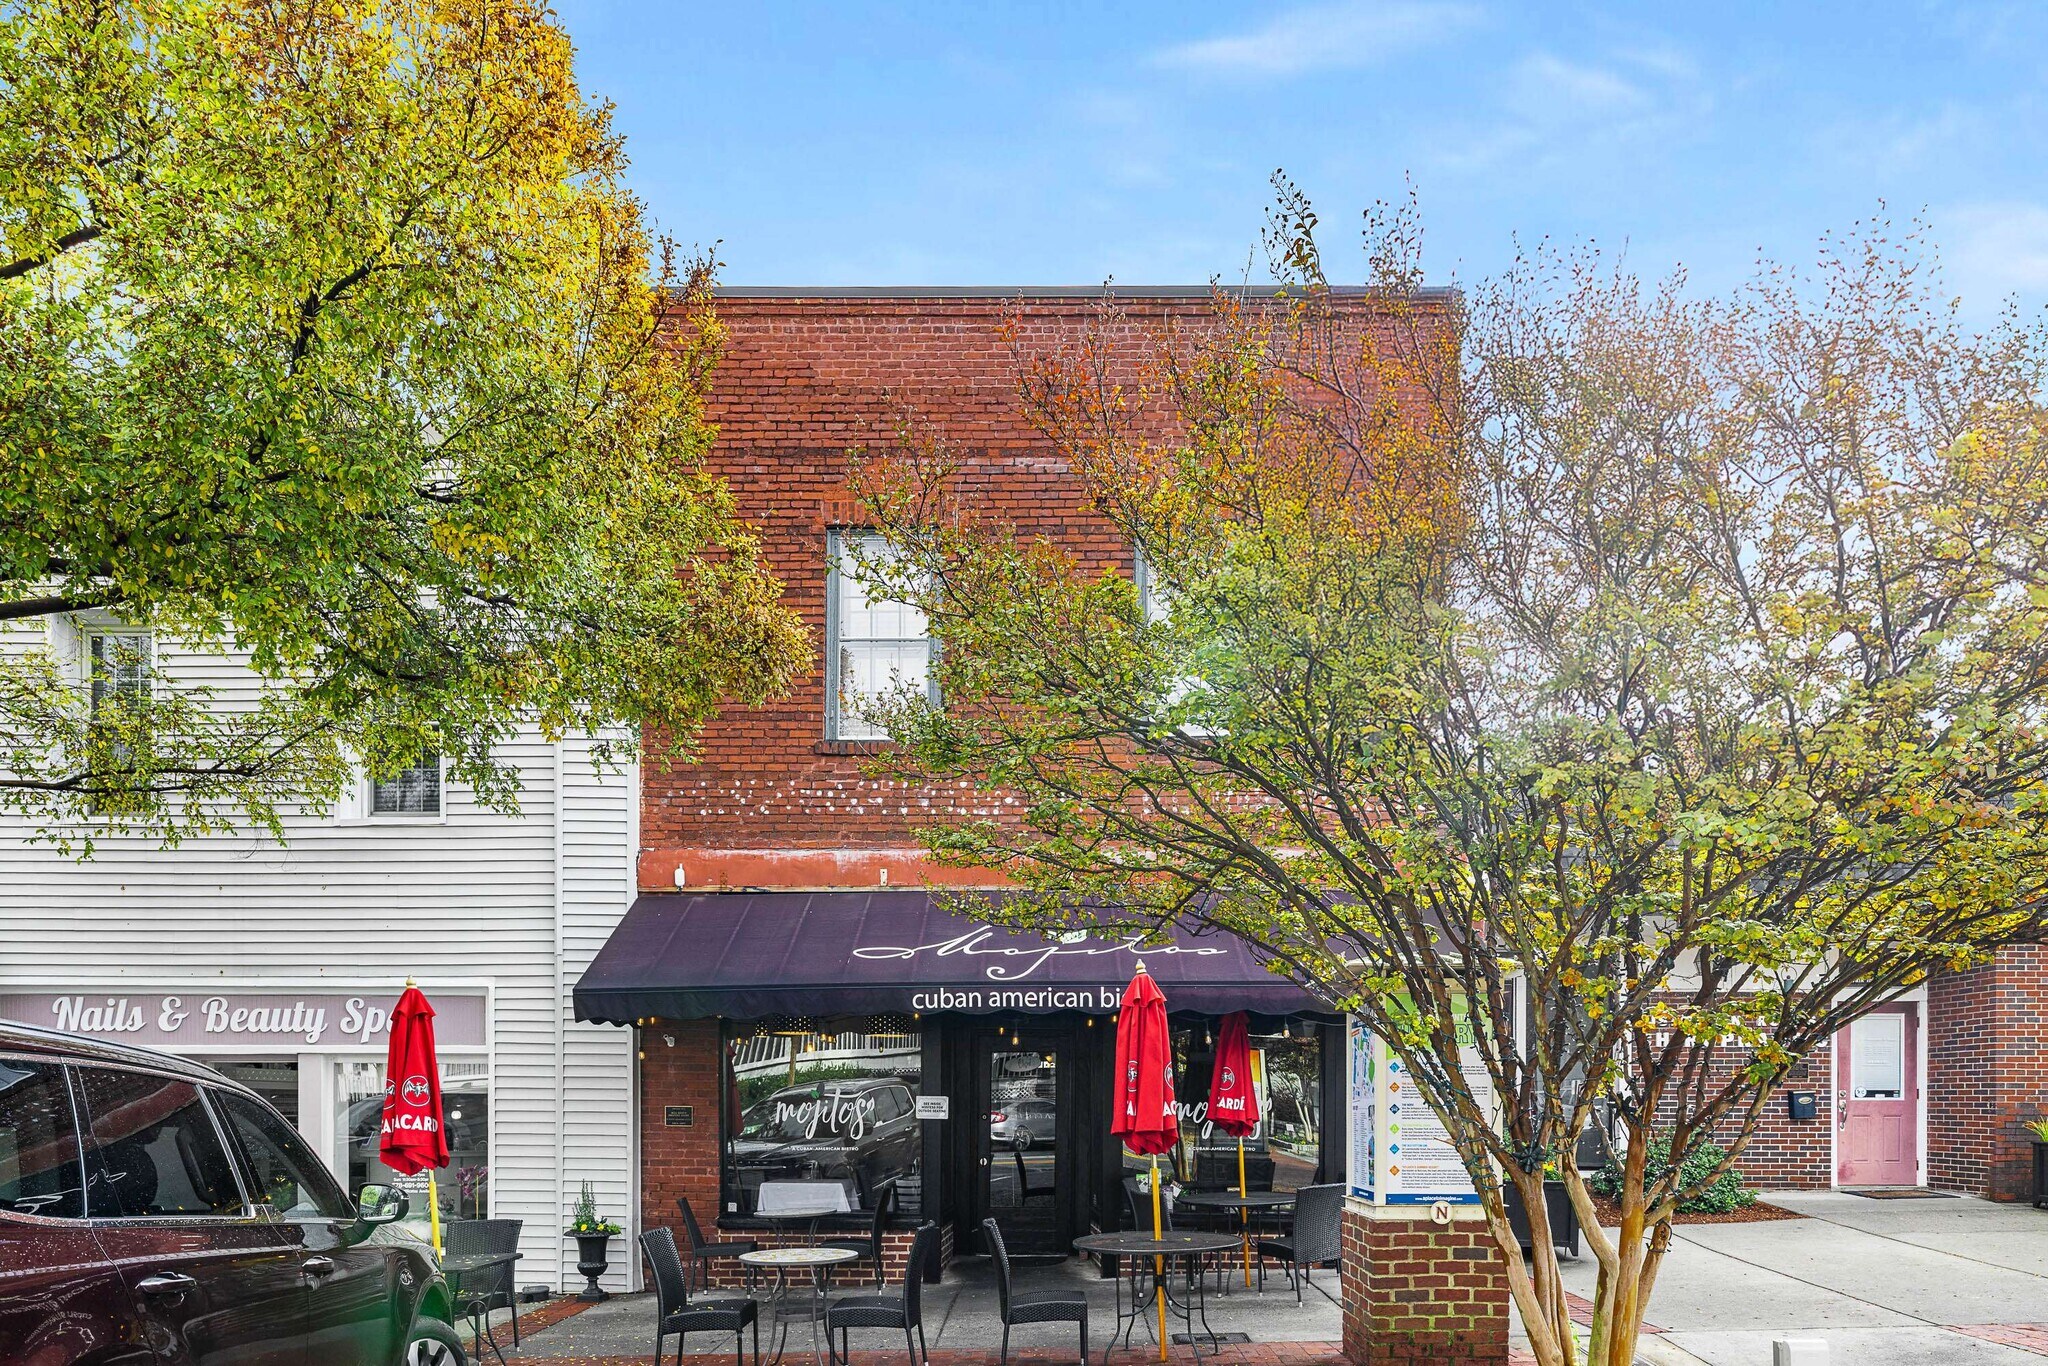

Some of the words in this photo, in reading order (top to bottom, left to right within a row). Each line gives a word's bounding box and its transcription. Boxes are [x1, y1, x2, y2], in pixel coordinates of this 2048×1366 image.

[853, 925, 1228, 980] Mojitos
[52, 996, 147, 1033] Nails
[158, 996, 190, 1033] &
[201, 996, 328, 1044] Beauty
[912, 988, 982, 1010] cuban
[988, 987, 1095, 1010] american
[1100, 986, 1121, 1009] bi
[775, 1087, 875, 1140] mojitos
[1435, 1206, 1448, 1219] N
